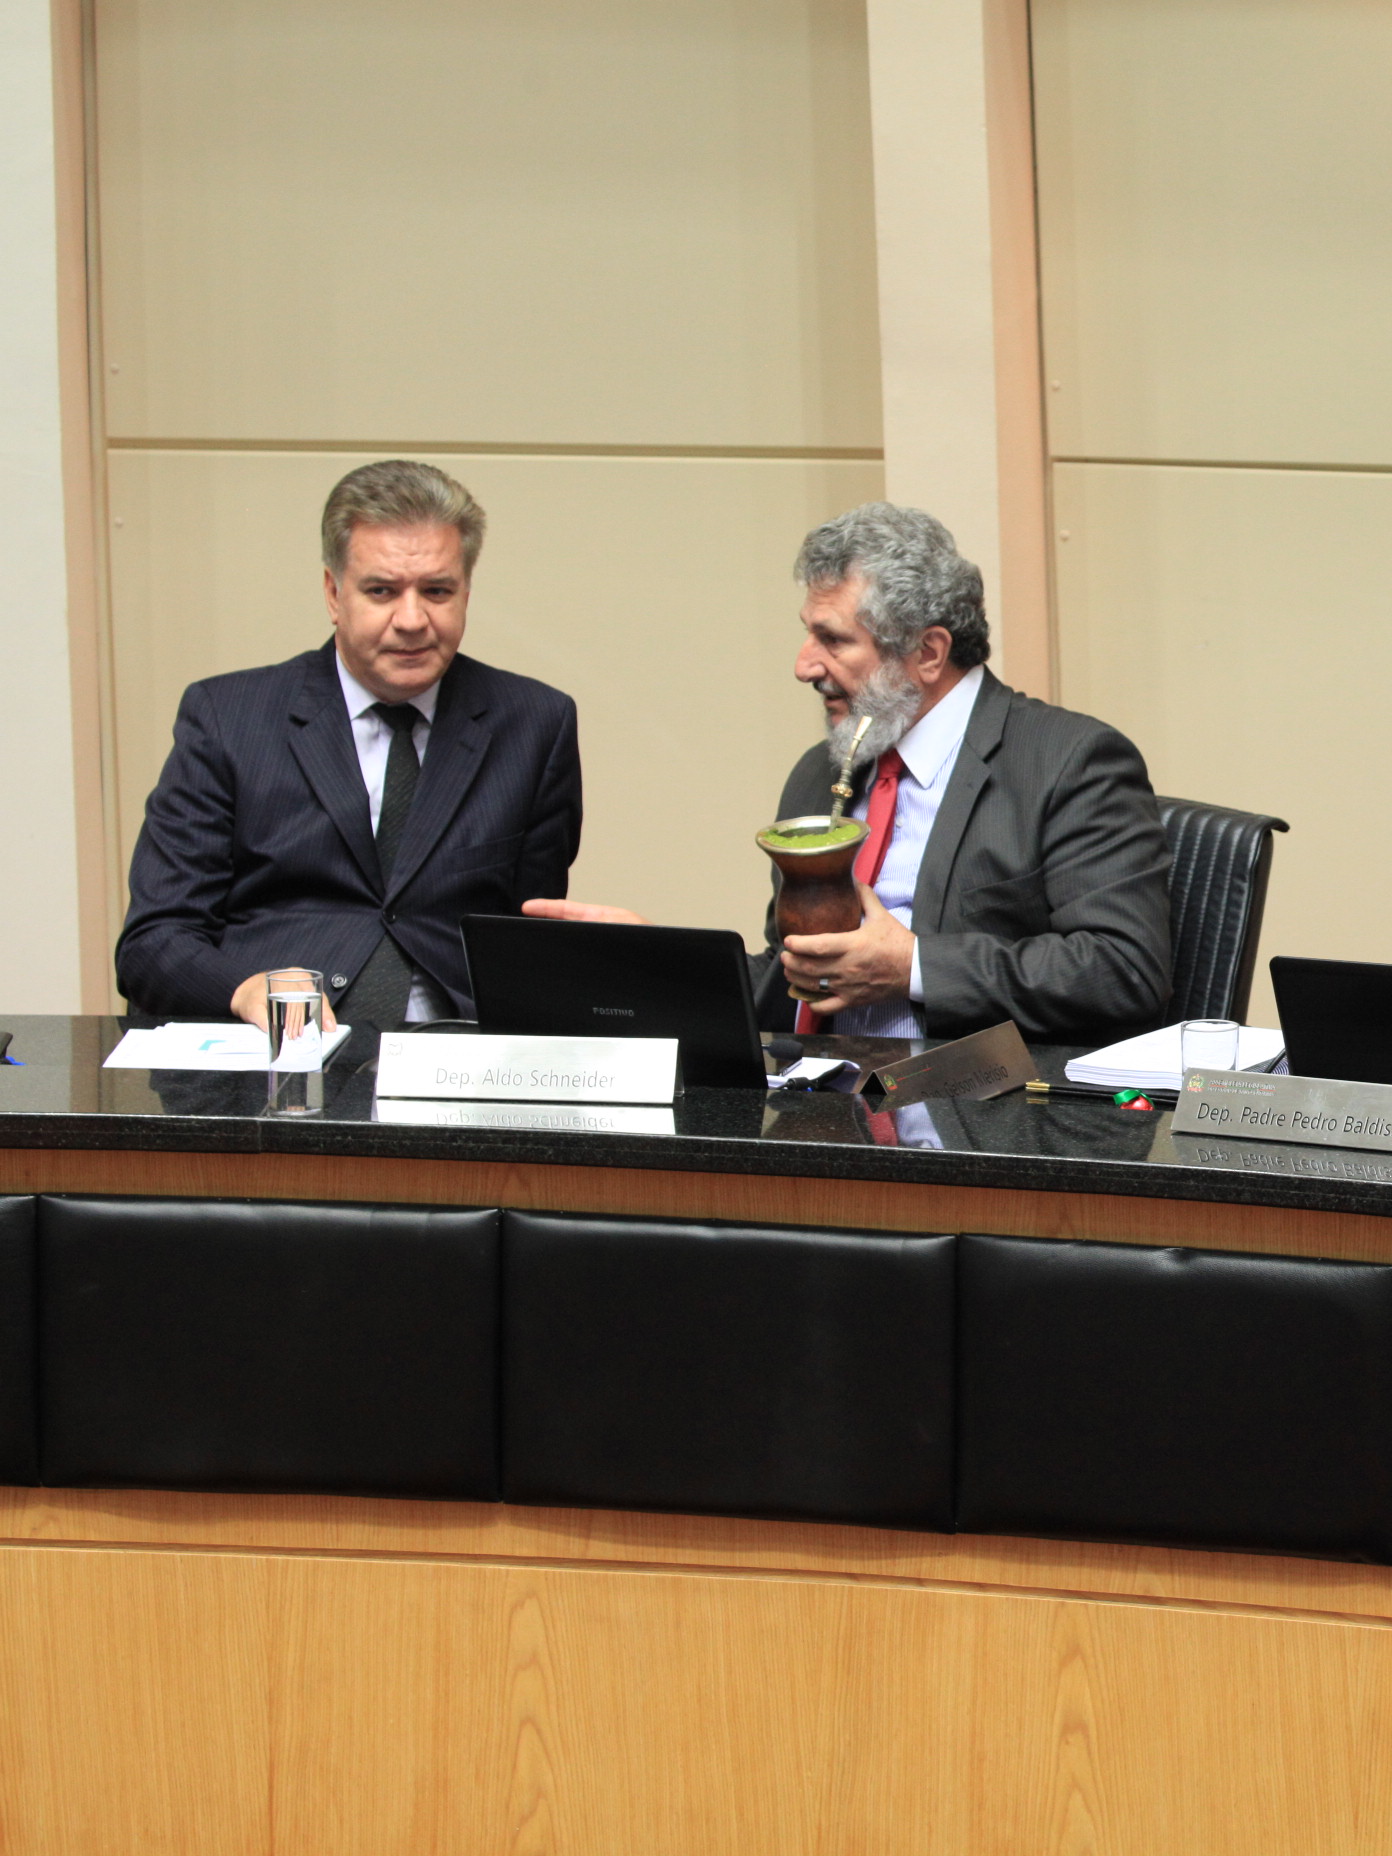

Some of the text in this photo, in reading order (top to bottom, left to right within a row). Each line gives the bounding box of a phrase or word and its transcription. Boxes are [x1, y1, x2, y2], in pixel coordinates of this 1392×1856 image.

[436, 1068, 617, 1089] Dep. Aldo Schneider
[1197, 1102, 1233, 1126] Dep.
[1240, 1106, 1286, 1127] Padre
[1290, 1111, 1338, 1132] Pedro
